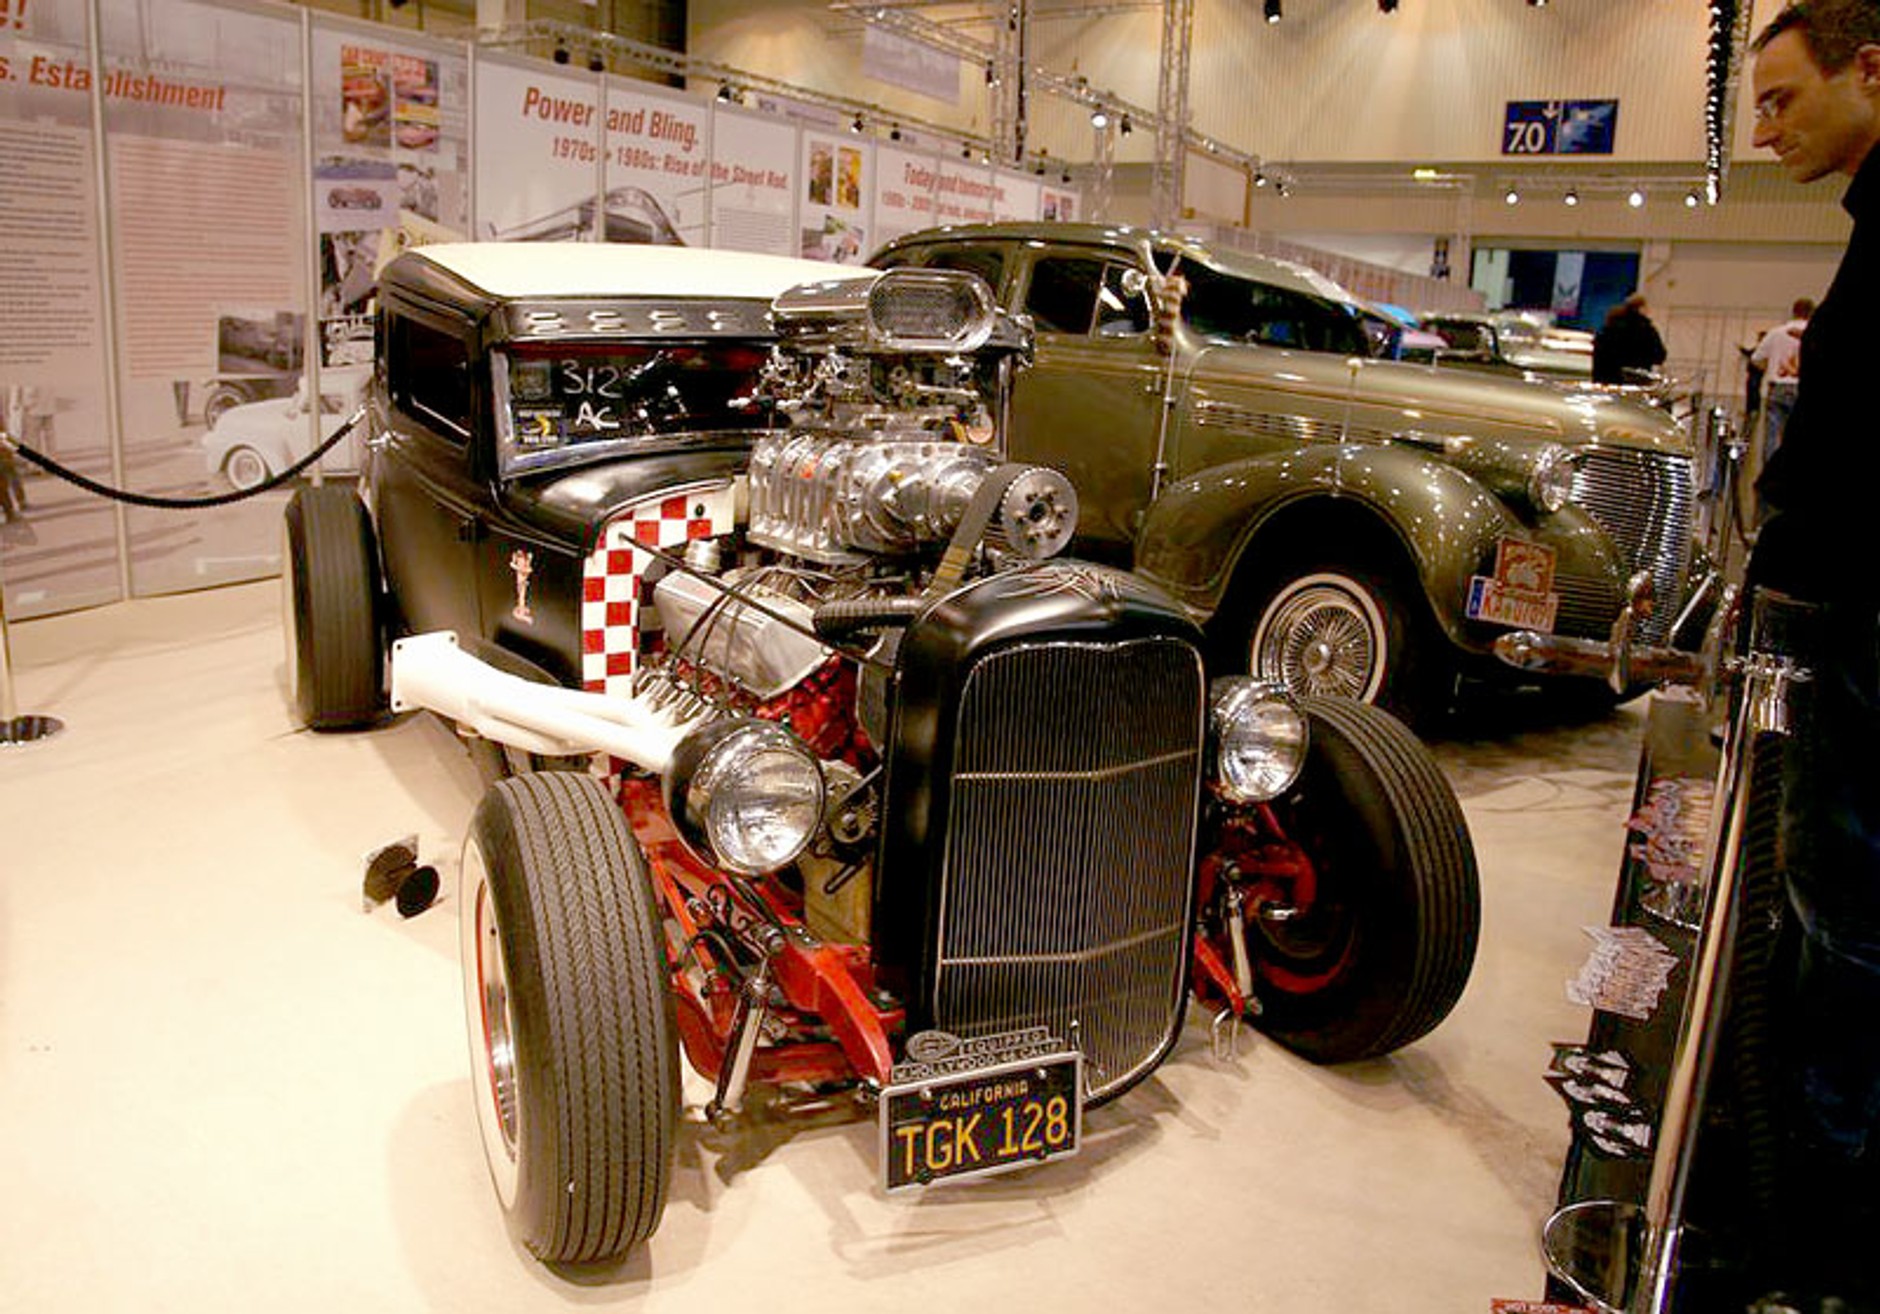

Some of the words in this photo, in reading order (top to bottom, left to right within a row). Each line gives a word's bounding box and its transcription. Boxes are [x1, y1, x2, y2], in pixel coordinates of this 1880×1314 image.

[523, 87, 594, 127] Power
[606, 107, 643, 135] and
[649, 111, 699, 150] Bling.
[1508, 121, 1546, 153] 7.0
[553, 137, 596, 162] 1970s
[663, 154, 690, 175] Rise
[561, 359, 623, 398] 312
[940, 1081, 1028, 1111] CALIFORNIA
[896, 1112, 981, 1176] TGK
[998, 1095, 1068, 1157] 128
